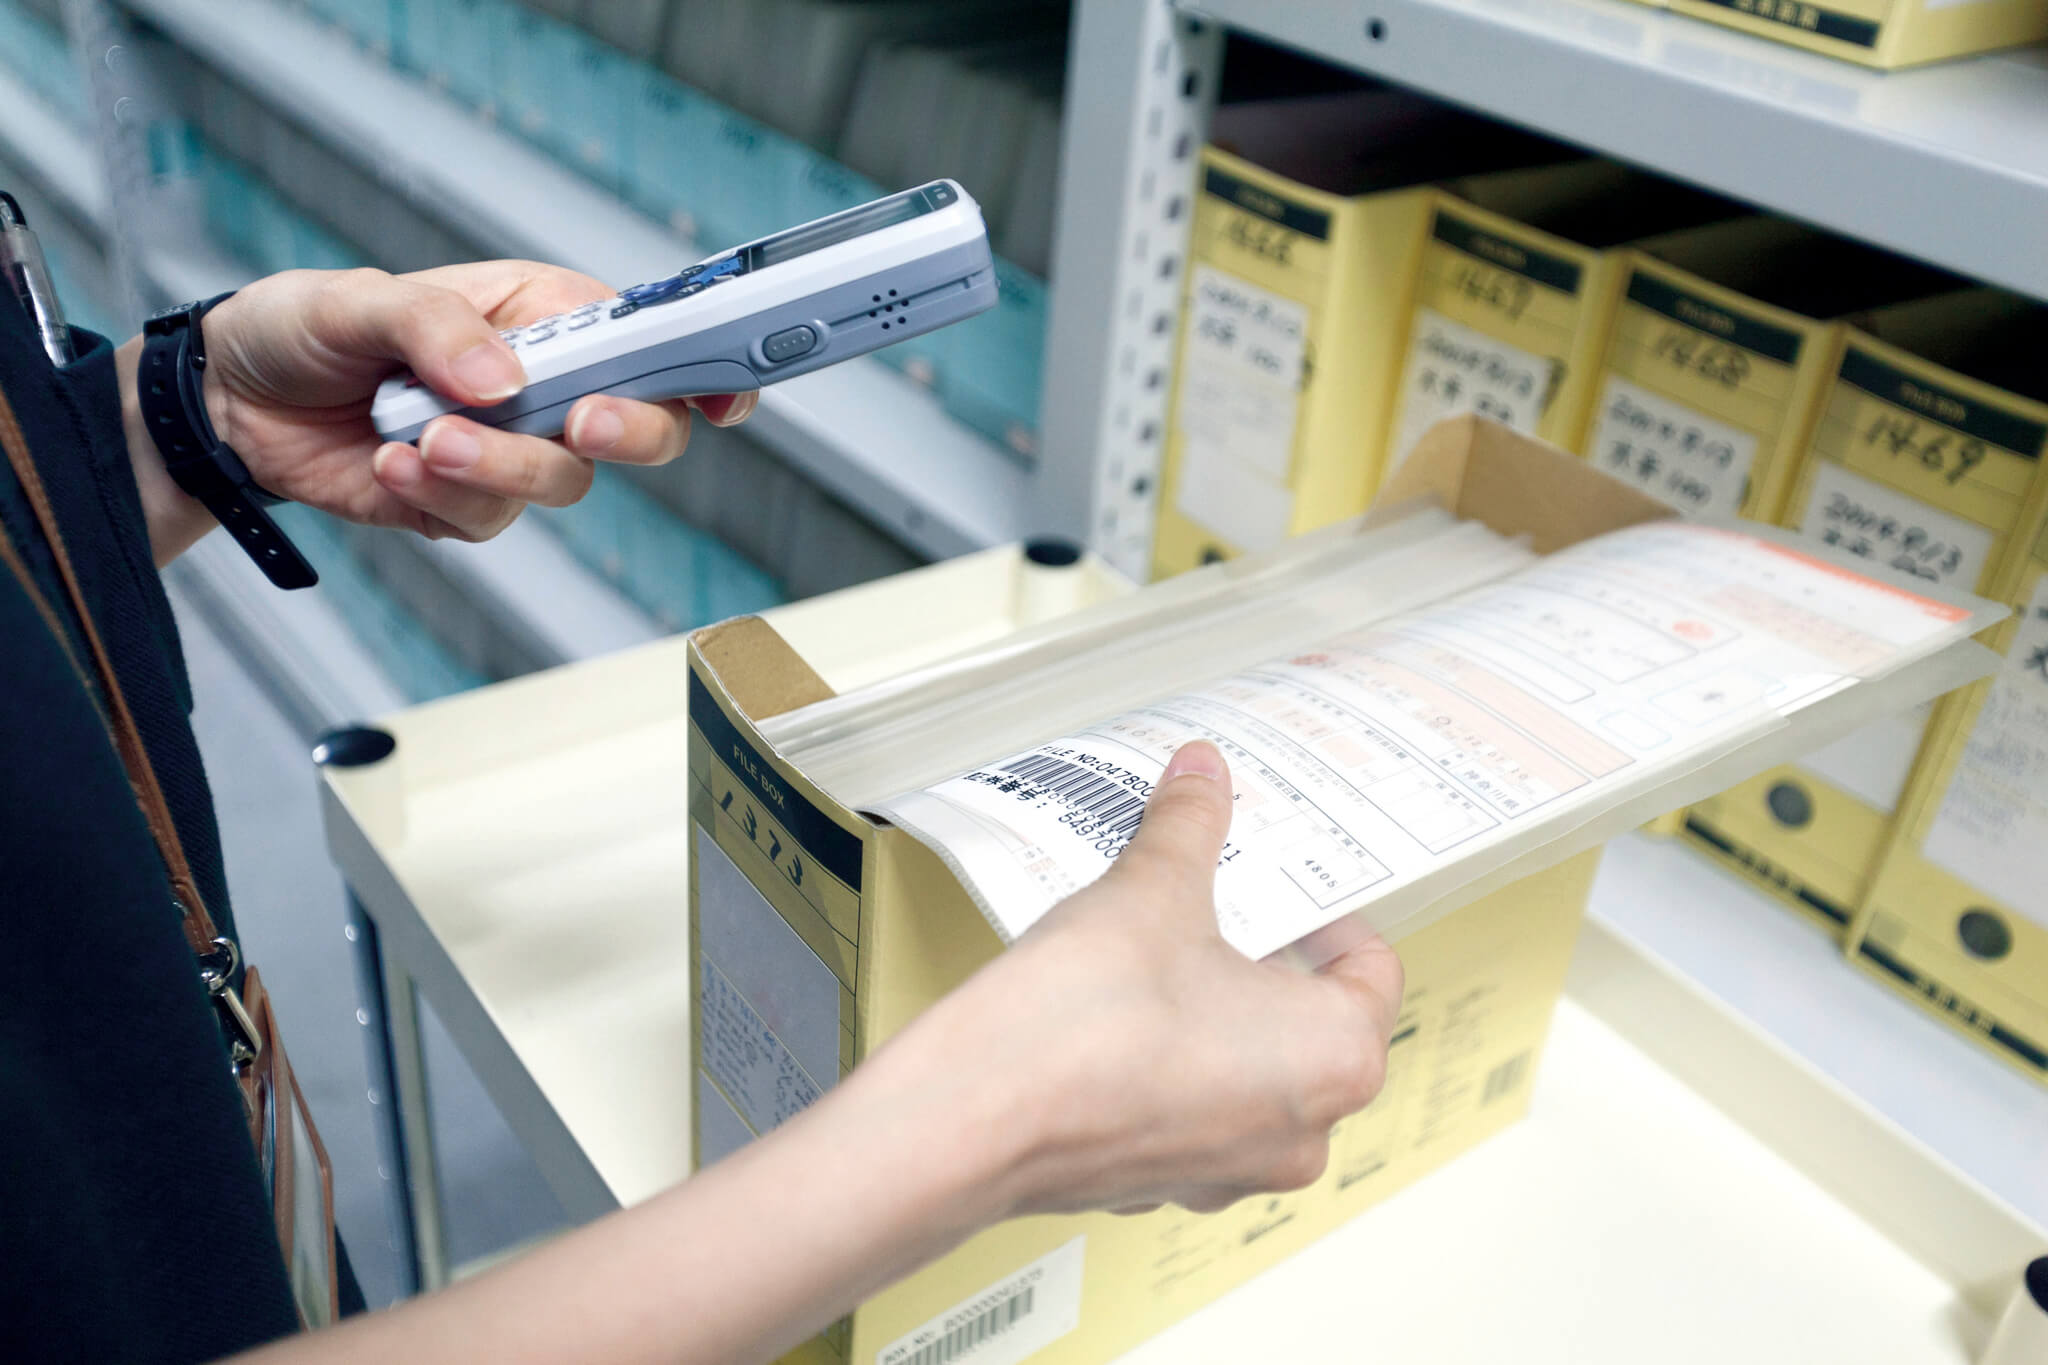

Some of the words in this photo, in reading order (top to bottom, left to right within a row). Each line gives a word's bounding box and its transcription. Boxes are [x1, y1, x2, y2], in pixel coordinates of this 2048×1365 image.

[1866, 410, 1987, 485] 1469
[733, 743, 759, 781] FILE
[761, 774, 785, 810] BOX
[1036, 746, 1075, 758] FILE
[720, 789, 803, 887] 1373
[1304, 858, 1338, 888] 4805
